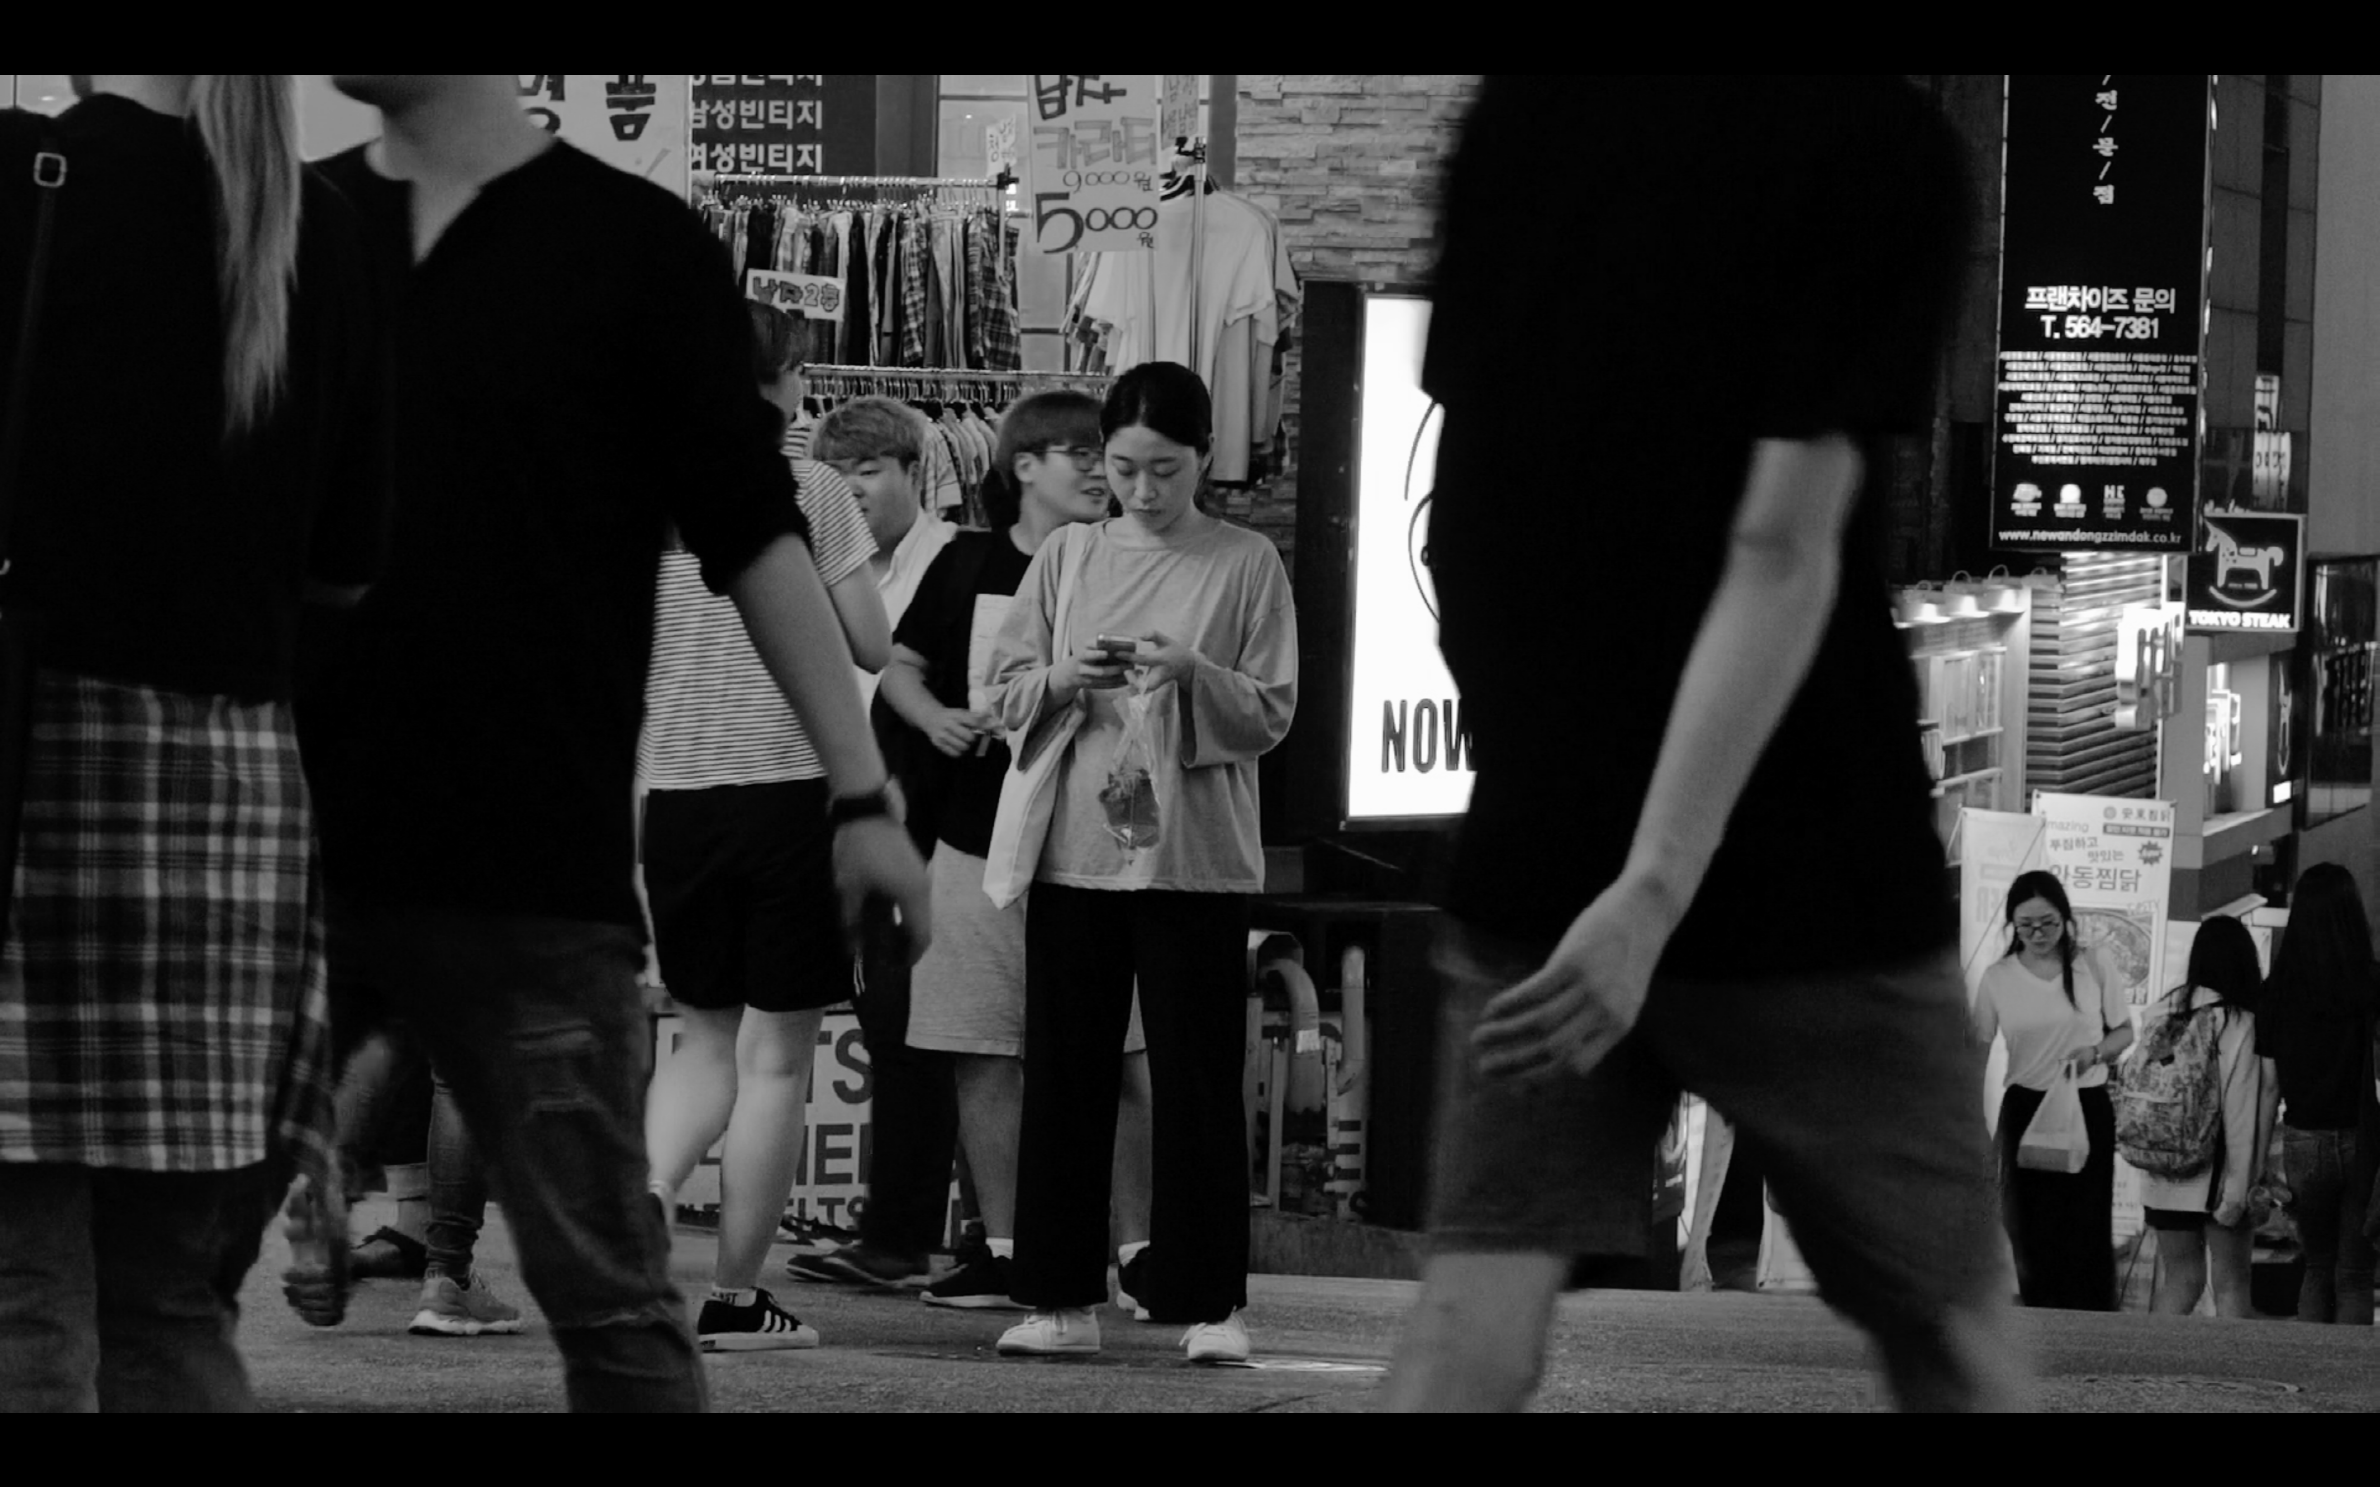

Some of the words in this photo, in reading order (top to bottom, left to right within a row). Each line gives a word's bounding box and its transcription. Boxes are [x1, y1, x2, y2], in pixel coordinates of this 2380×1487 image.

[1035, 192, 1158, 254] 5000
[2024, 285, 2129, 313] 프랜차이즈
[2132, 287, 2176, 314] 문의
[2040, 315, 2061, 339] T.
[2064, 315, 2159, 339] 564-7381
[2188, 609, 2242, 628] TOKYO
[2242, 611, 2290, 629] STEAK
[2048, 820, 2089, 833] mazing
